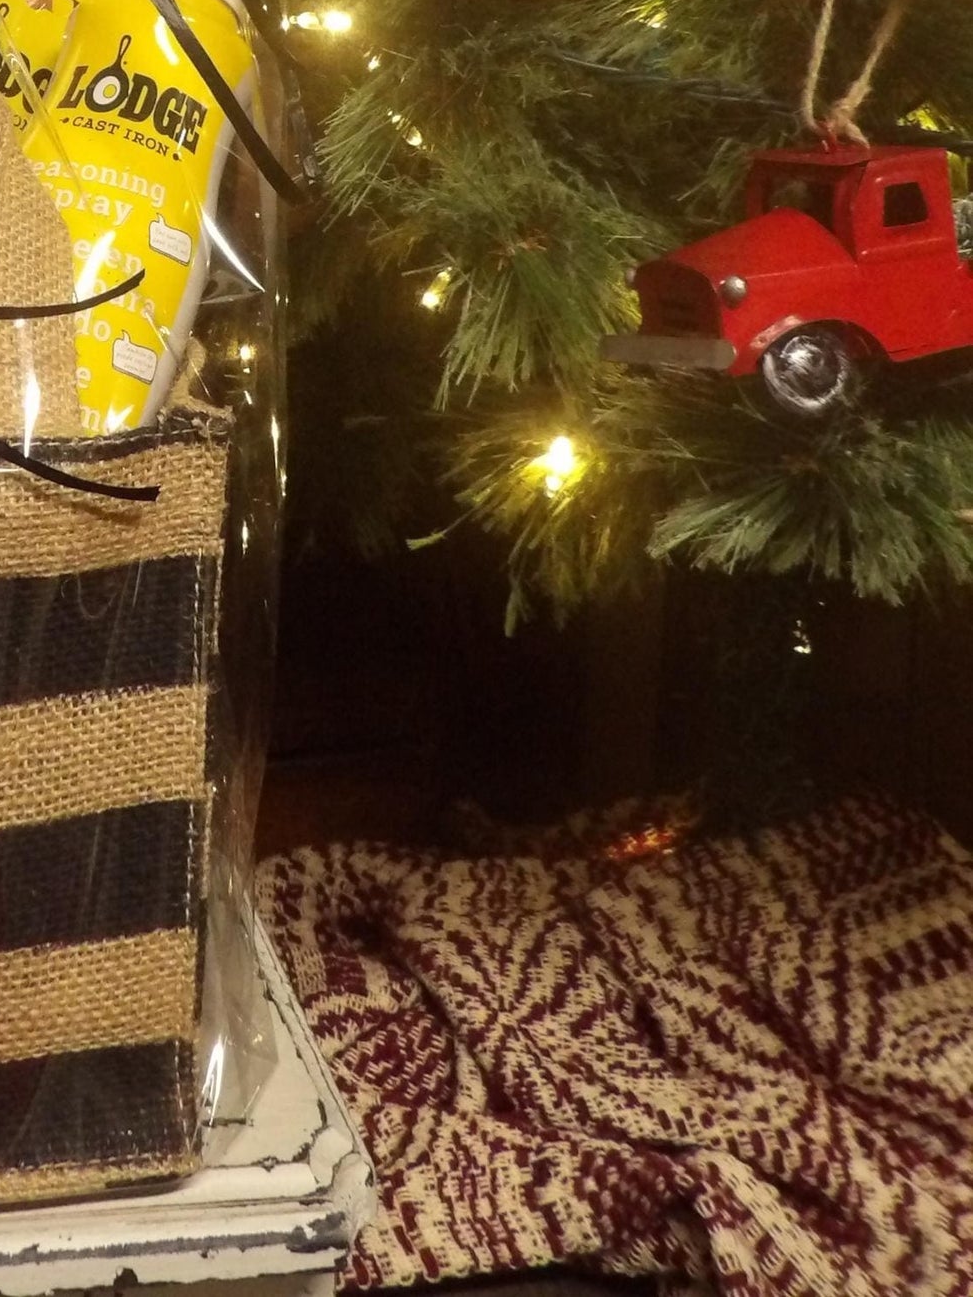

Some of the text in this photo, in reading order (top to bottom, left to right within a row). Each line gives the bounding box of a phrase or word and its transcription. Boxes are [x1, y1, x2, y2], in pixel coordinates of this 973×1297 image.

[56, 60, 208, 155] LODGE
[72, 116, 169, 157] CAST IRON
[29, 159, 166, 208] easoning
[41, 182, 133, 227] pray
